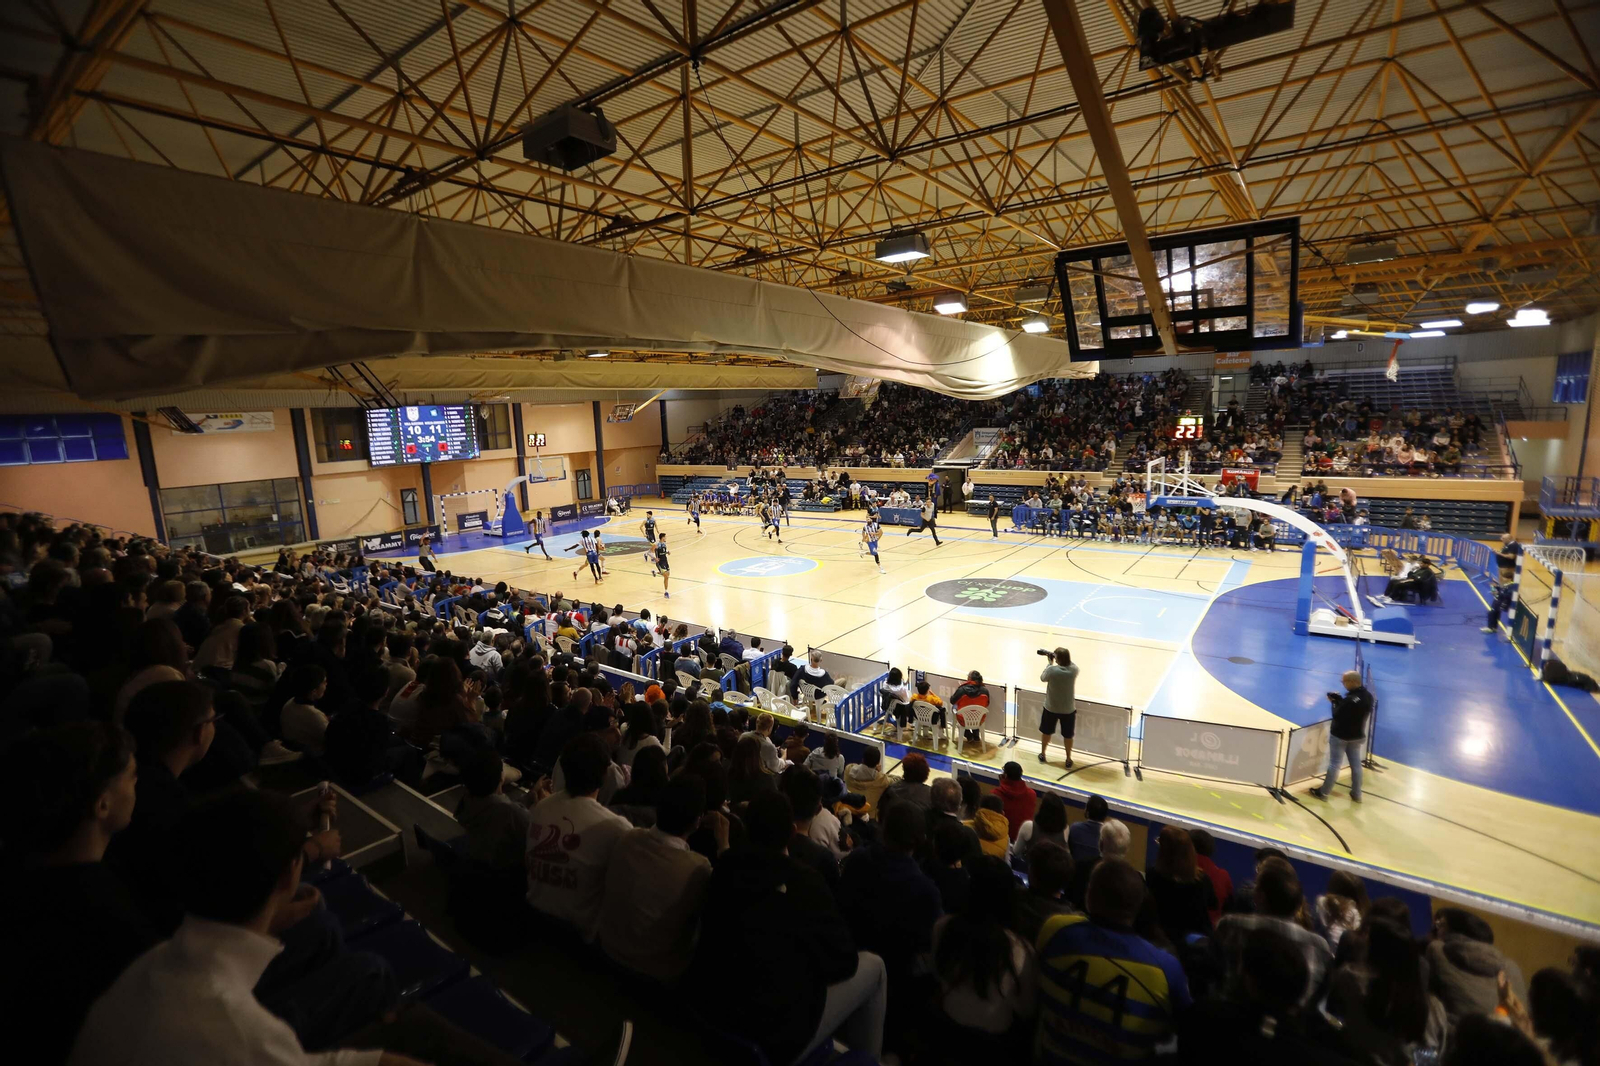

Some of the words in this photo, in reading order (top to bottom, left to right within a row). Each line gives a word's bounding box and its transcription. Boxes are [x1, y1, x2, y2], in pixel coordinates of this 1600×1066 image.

[408, 425, 422, 435] 10
[429, 424, 442, 434] 11
[1175, 426, 1196, 438] 22
[417, 435, 436, 443] 3:54
